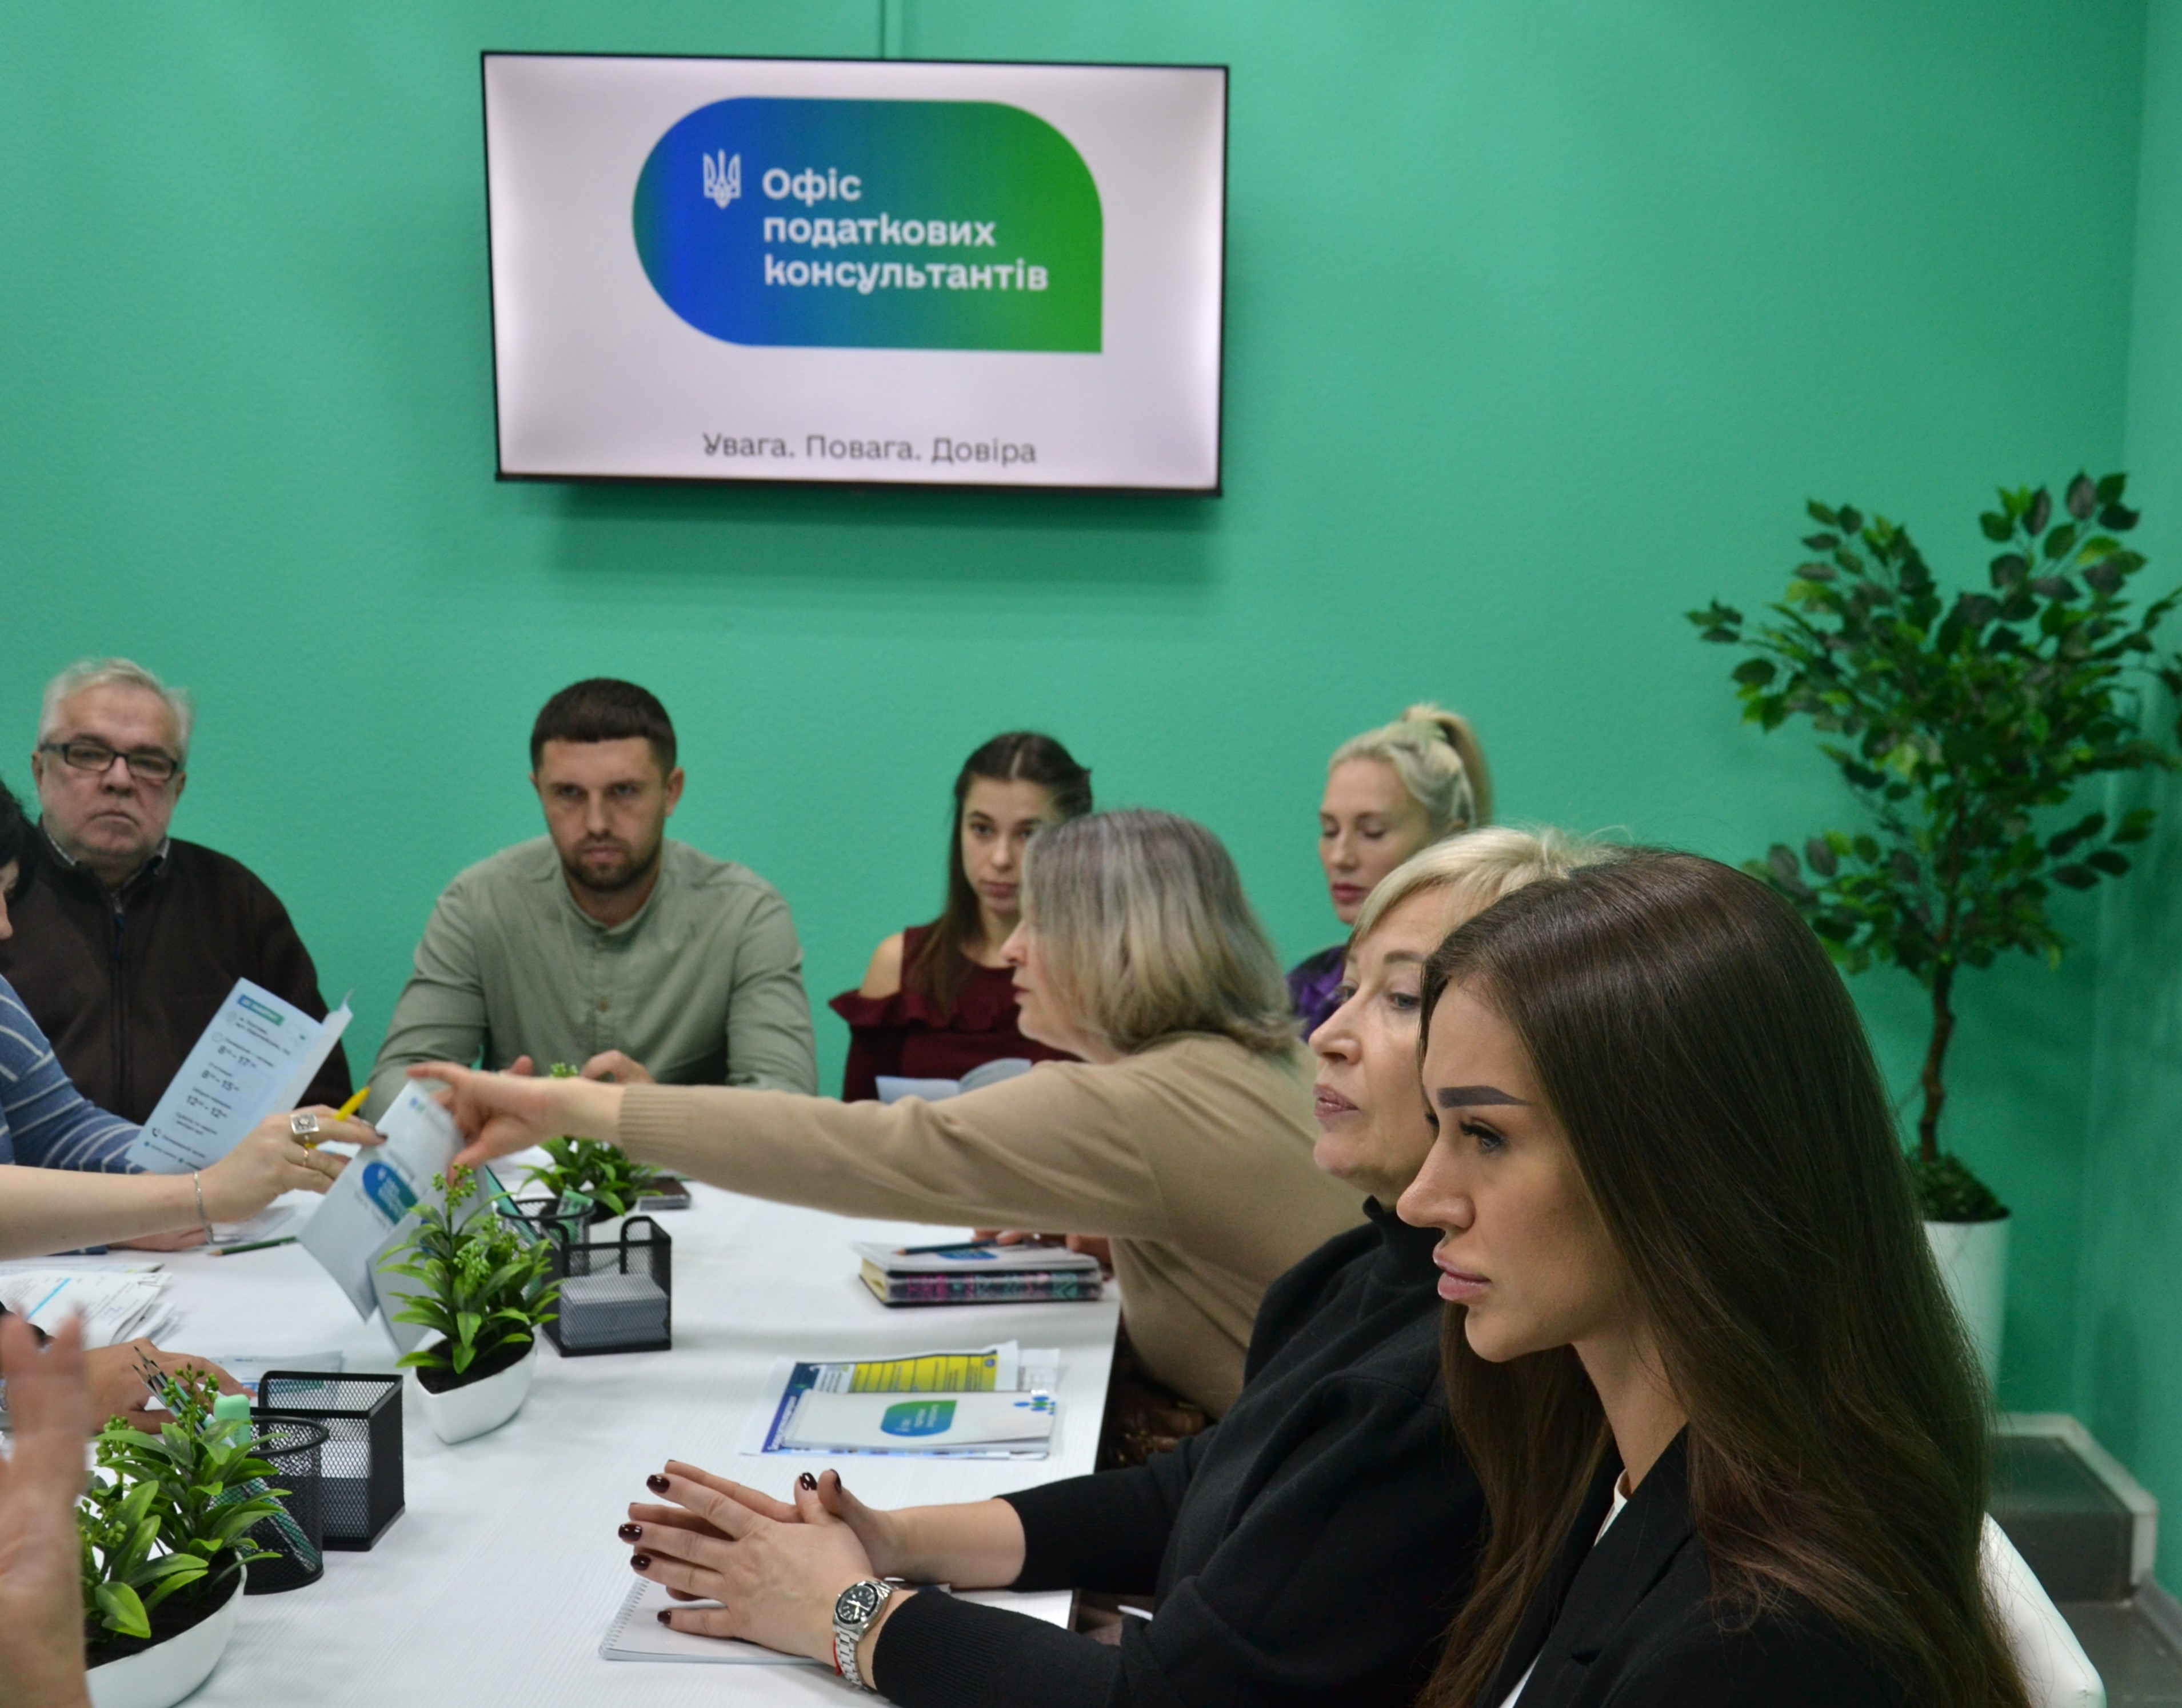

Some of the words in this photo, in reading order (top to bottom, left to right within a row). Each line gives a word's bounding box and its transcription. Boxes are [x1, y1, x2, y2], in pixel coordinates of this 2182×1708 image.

[762, 167, 861, 206] Офіс
[764, 213, 996, 248] податкових
[765, 254, 1049, 294] консультантів
[703, 433, 795, 458] Увага.
[806, 435, 921, 460] Повага.
[931, 437, 1037, 466] Довіра
